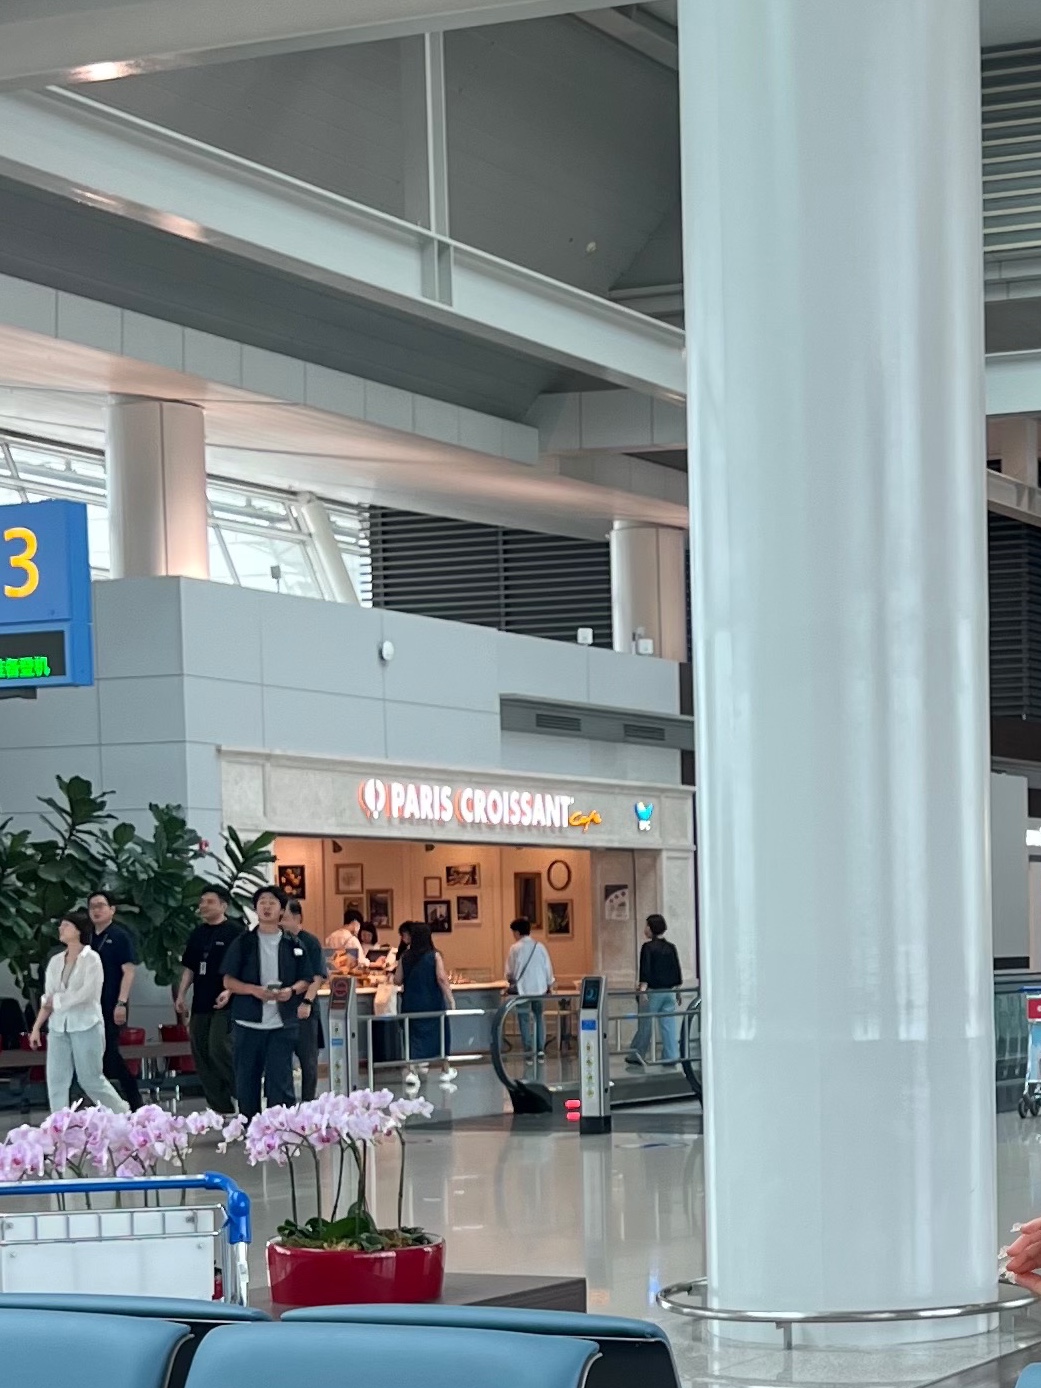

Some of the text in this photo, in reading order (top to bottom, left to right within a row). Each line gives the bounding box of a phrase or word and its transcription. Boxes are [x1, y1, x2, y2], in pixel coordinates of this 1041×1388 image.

[3, 526, 41, 599] 3
[390, 781, 453, 822] PARIS
[461, 787, 573, 828] CROISSANT
